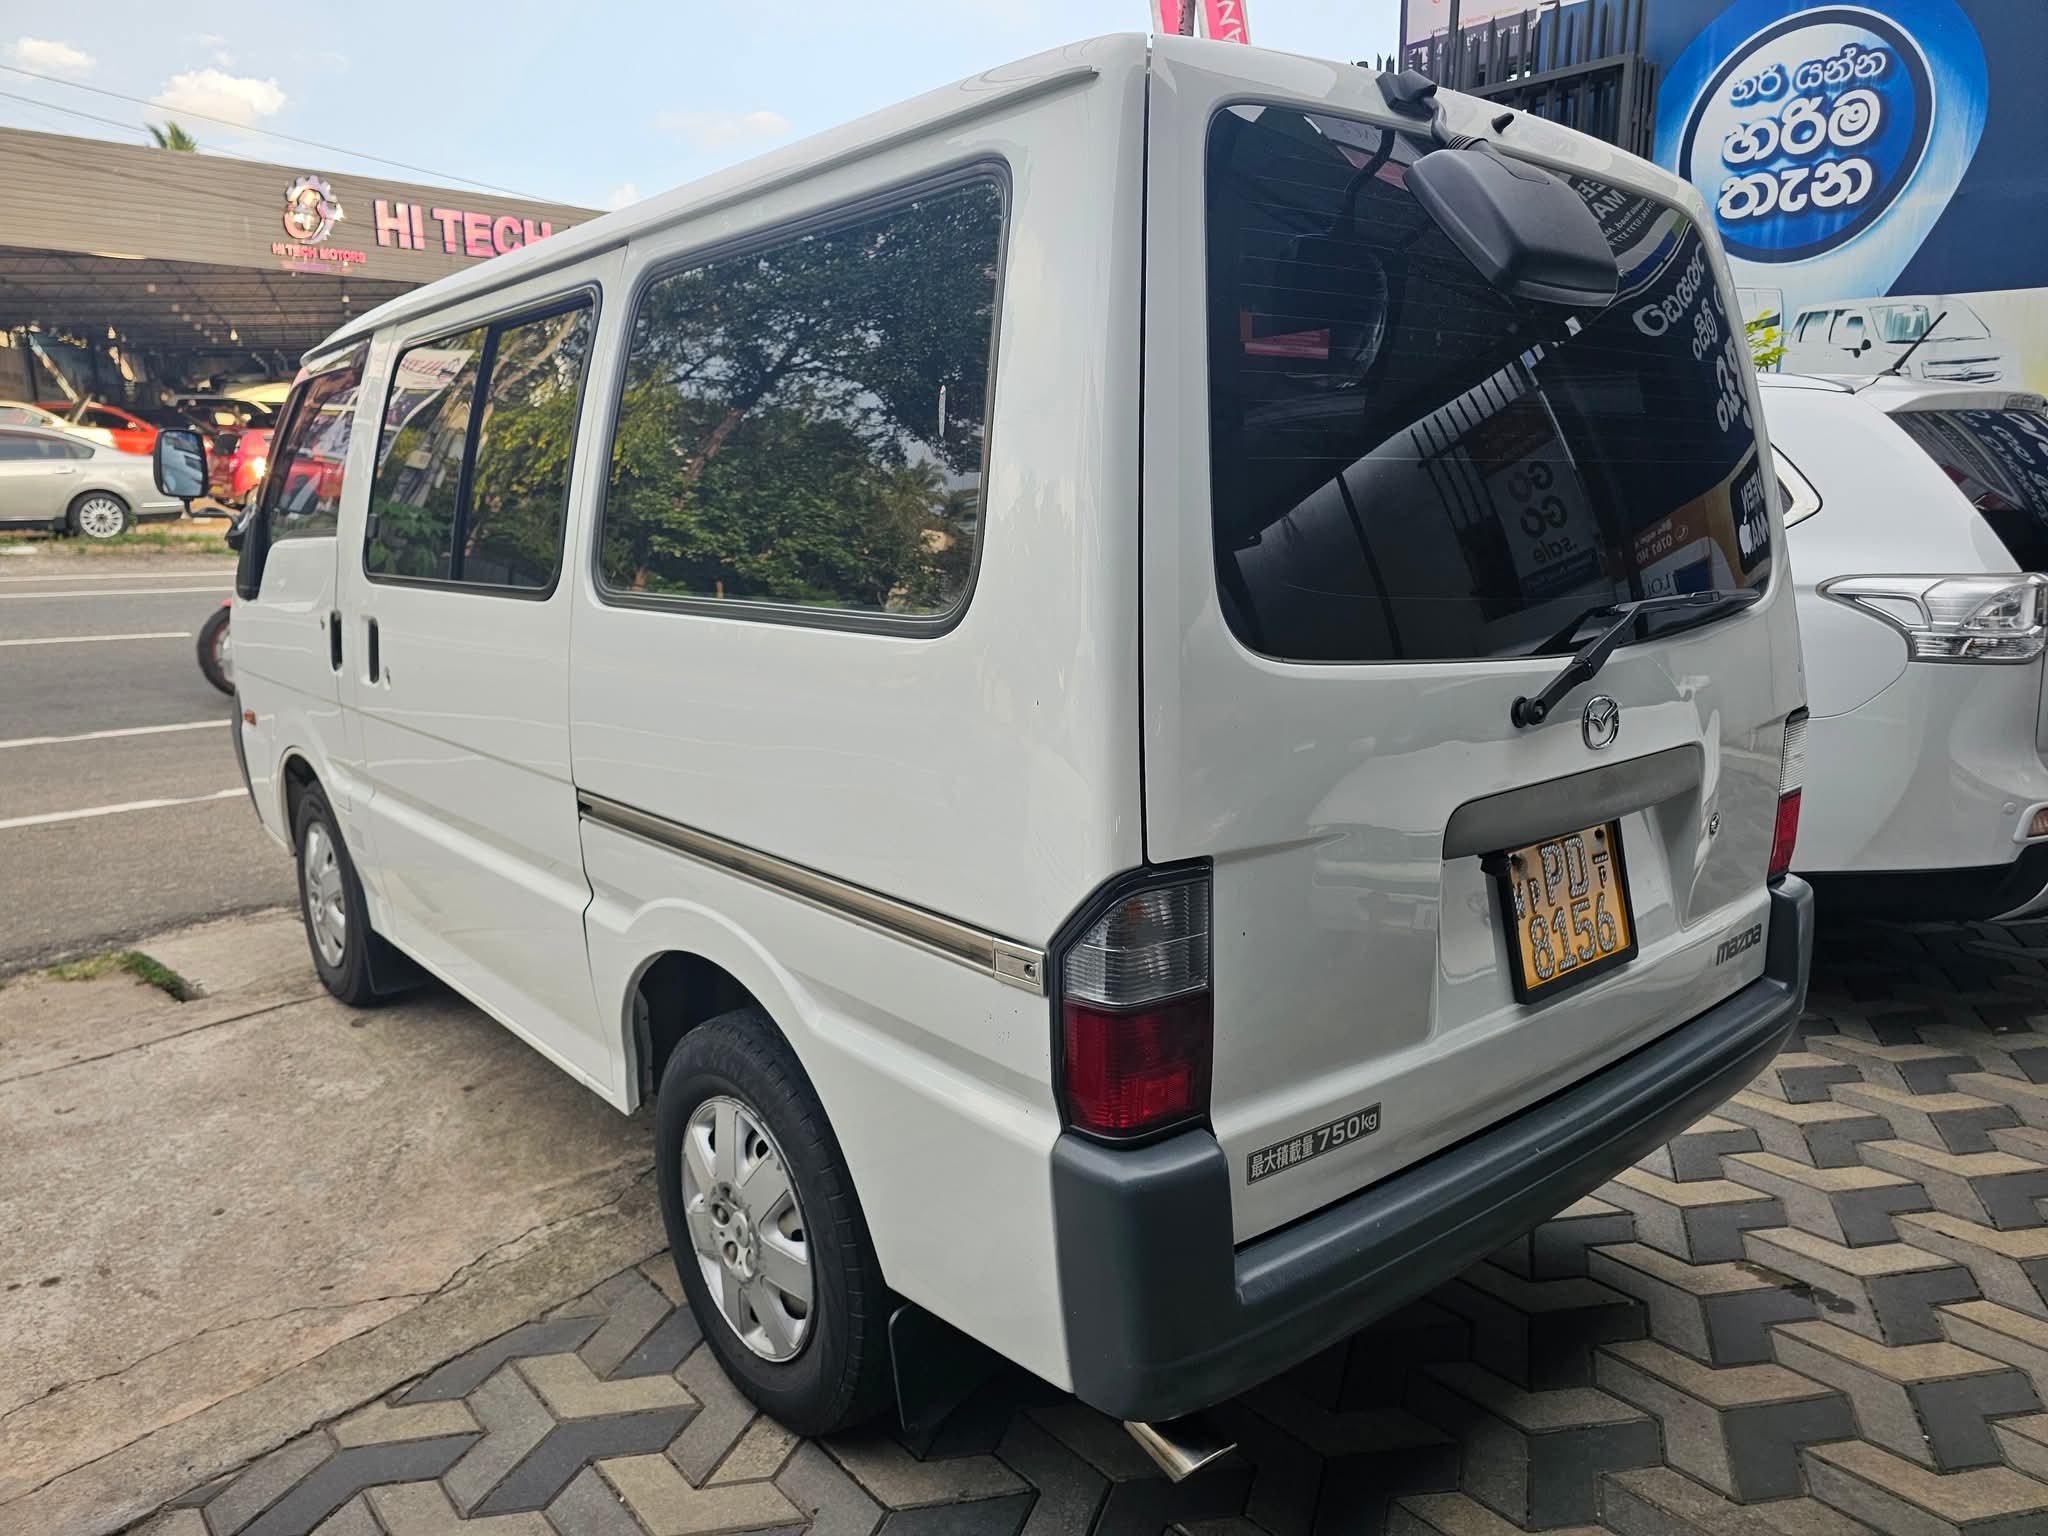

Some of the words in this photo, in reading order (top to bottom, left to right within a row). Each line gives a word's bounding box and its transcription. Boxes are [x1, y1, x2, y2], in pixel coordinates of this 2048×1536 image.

[1796, 46, 1887, 89] යන්න
[1721, 88, 1881, 164] හරිම
[1717, 157, 1873, 220] තැන
[272, 242, 285, 255] HI
[373, 199, 426, 250] HI
[432, 207, 552, 258] TECH
[1530, 892, 1617, 980] 8156
[1716, 923, 1762, 967] mazda
[1250, 1134, 1315, 1179] 最大積載量
